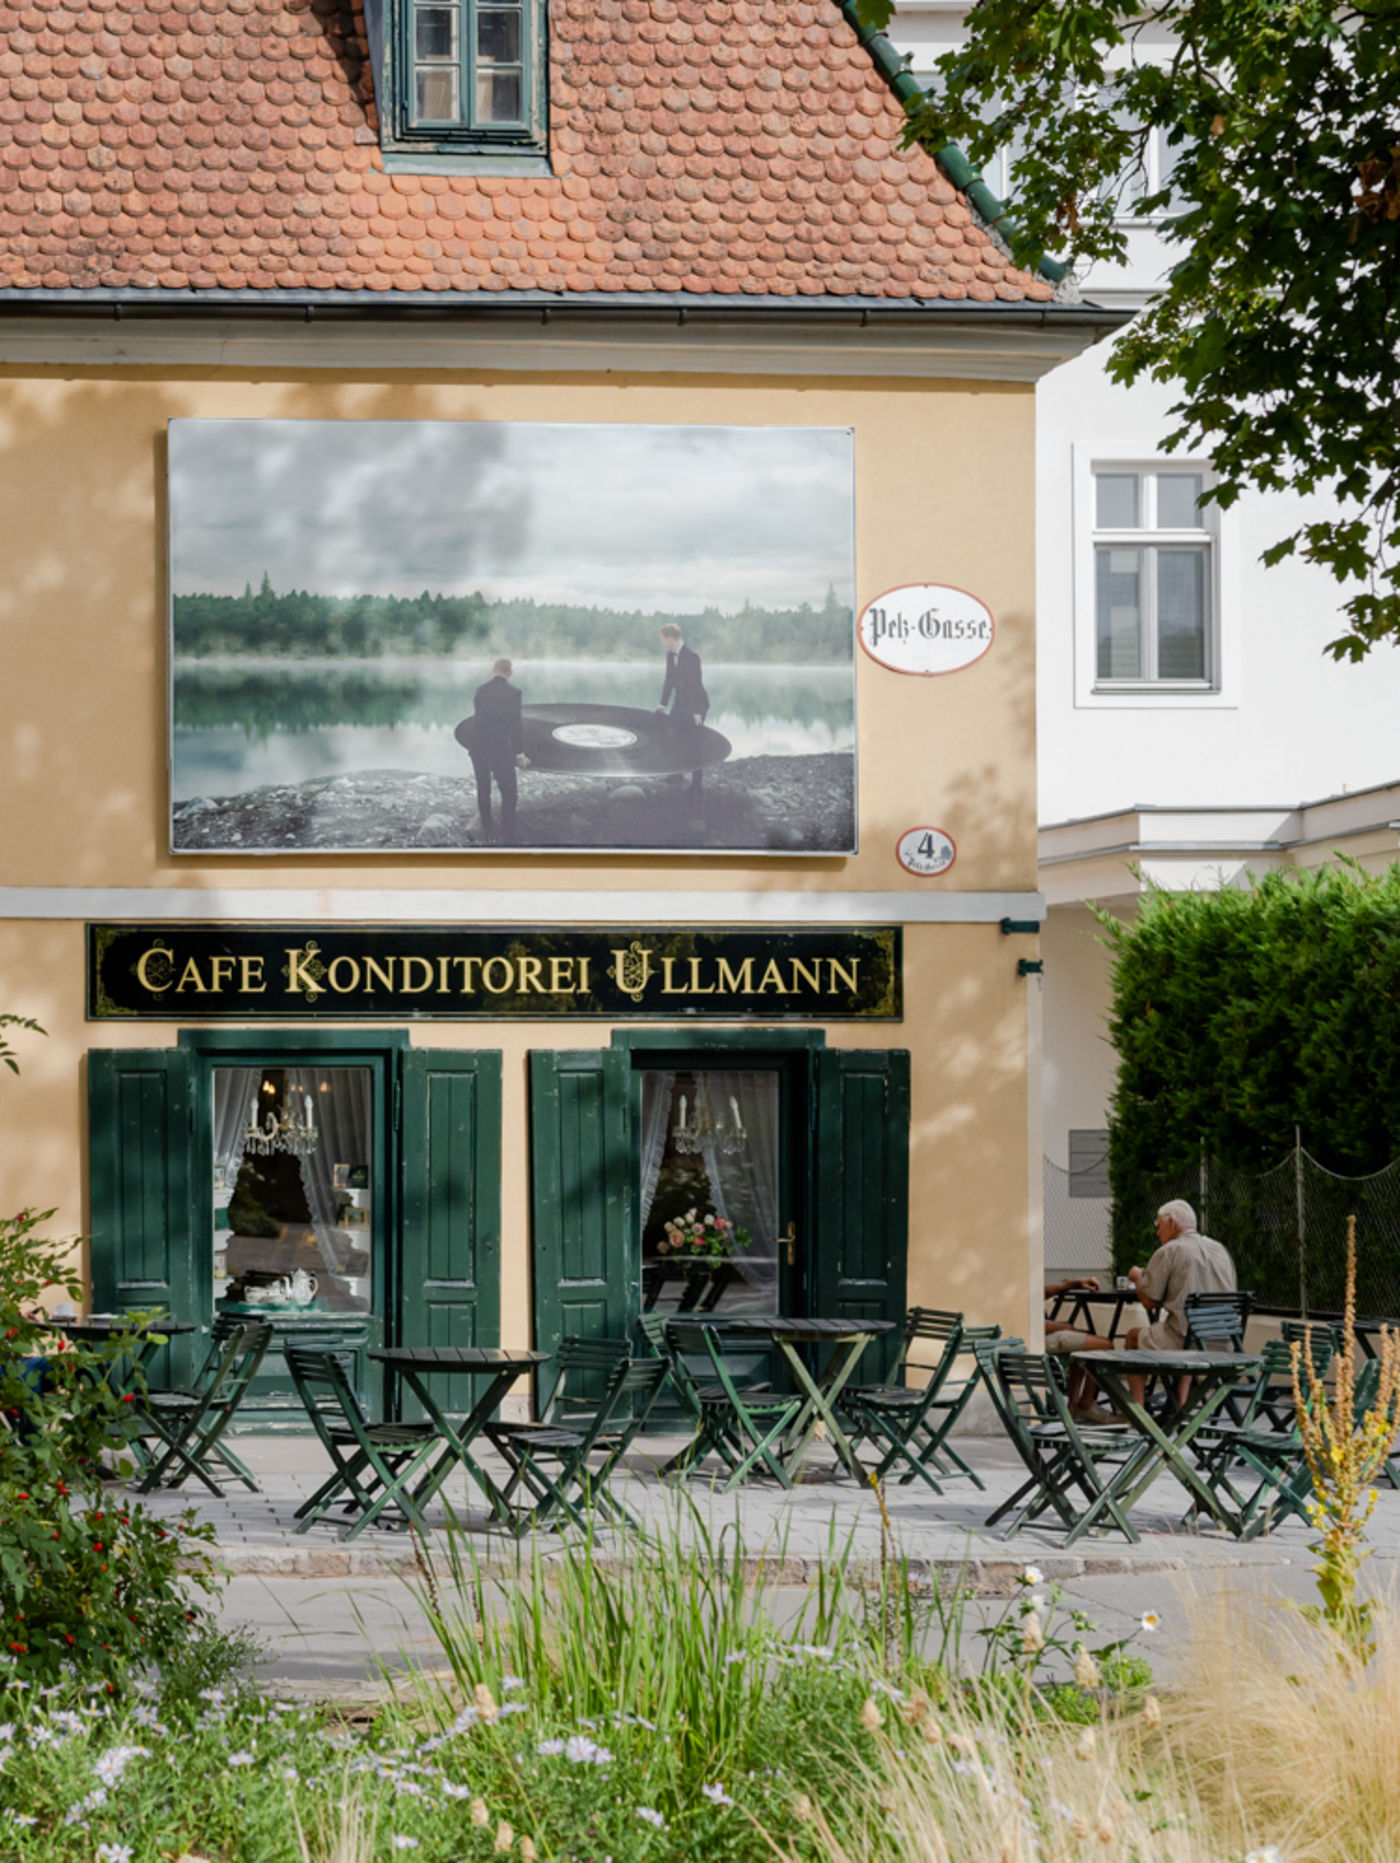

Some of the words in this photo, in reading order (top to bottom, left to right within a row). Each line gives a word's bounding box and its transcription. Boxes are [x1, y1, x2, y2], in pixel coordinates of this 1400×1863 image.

[918, 832, 935, 859] 4
[136, 947, 267, 993] CAFE
[284, 949, 592, 994] KONDITOREI
[610, 950, 861, 994] ULLMANN
